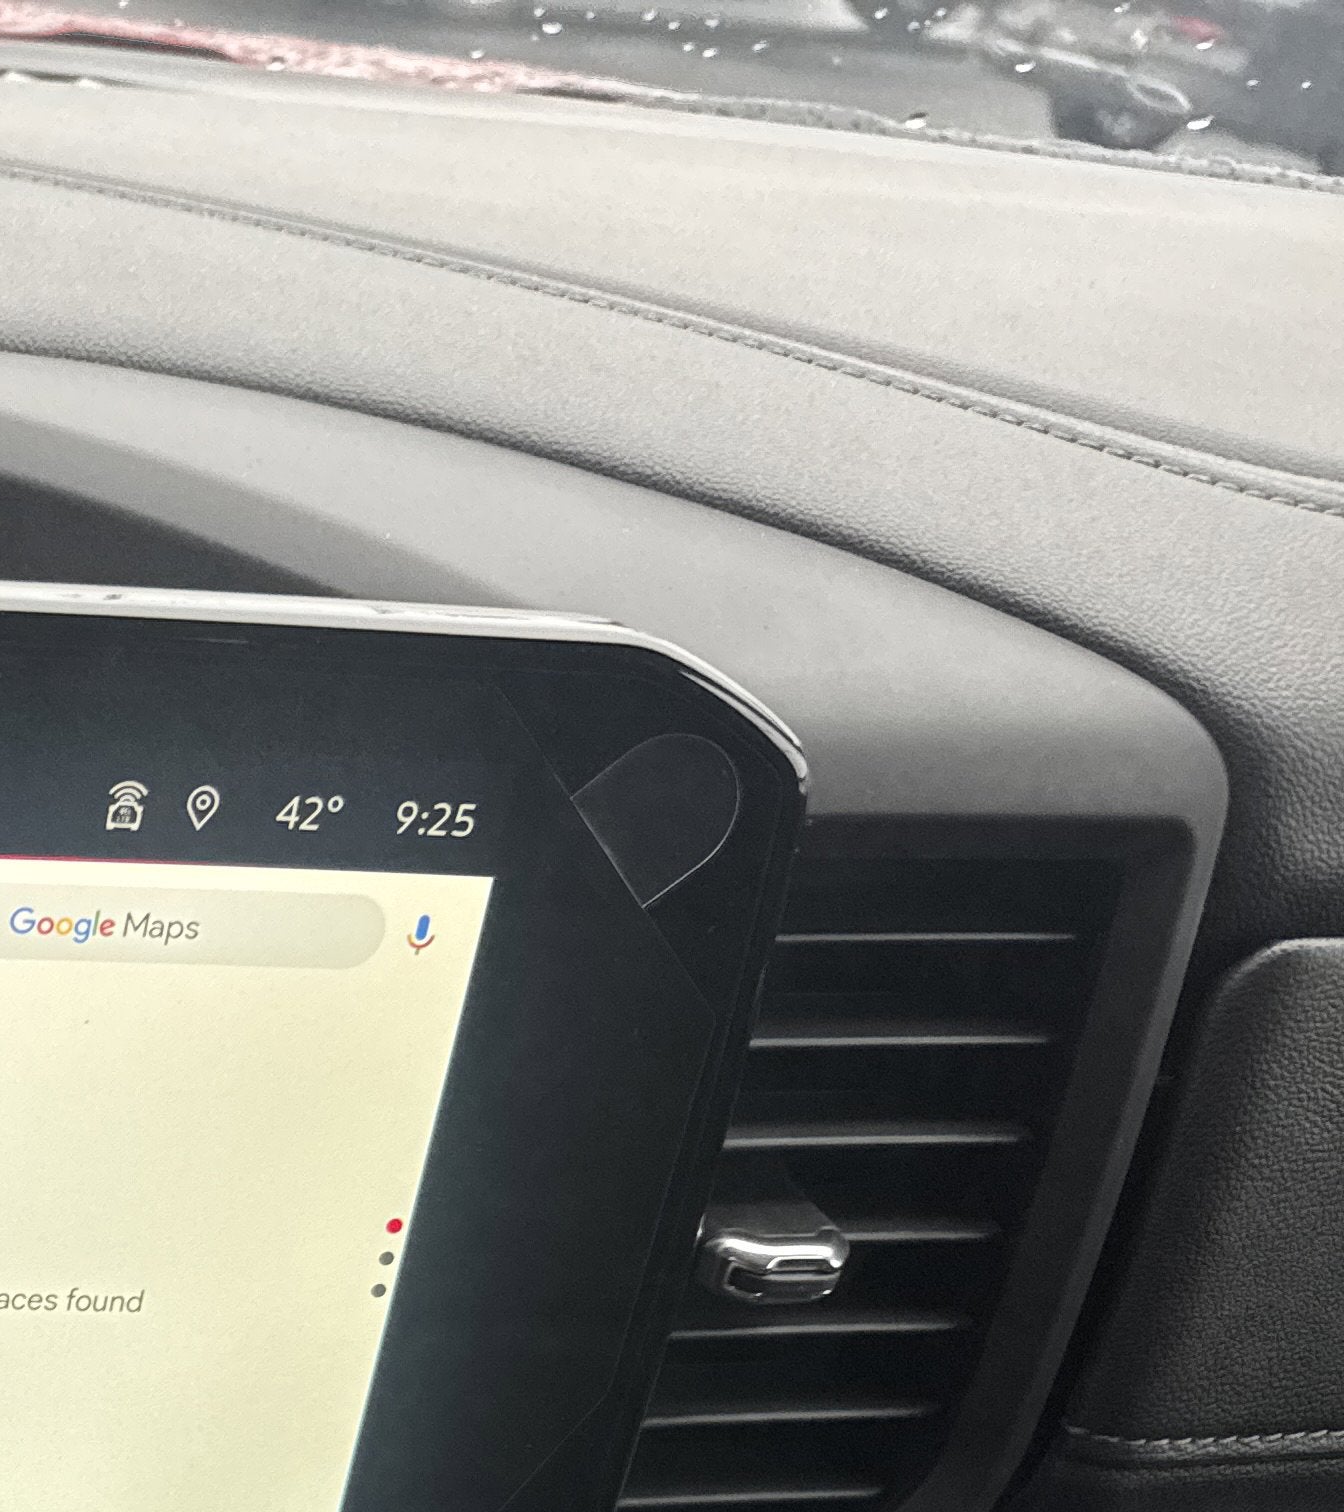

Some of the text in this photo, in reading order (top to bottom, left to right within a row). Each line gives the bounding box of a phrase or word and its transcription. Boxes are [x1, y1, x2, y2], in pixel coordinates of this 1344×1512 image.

[276, 796, 345, 830] 42°
[395, 801, 476, 837] 9:25
[9, 906, 200, 946] Google Maps
[65, 1286, 145, 1314] found
